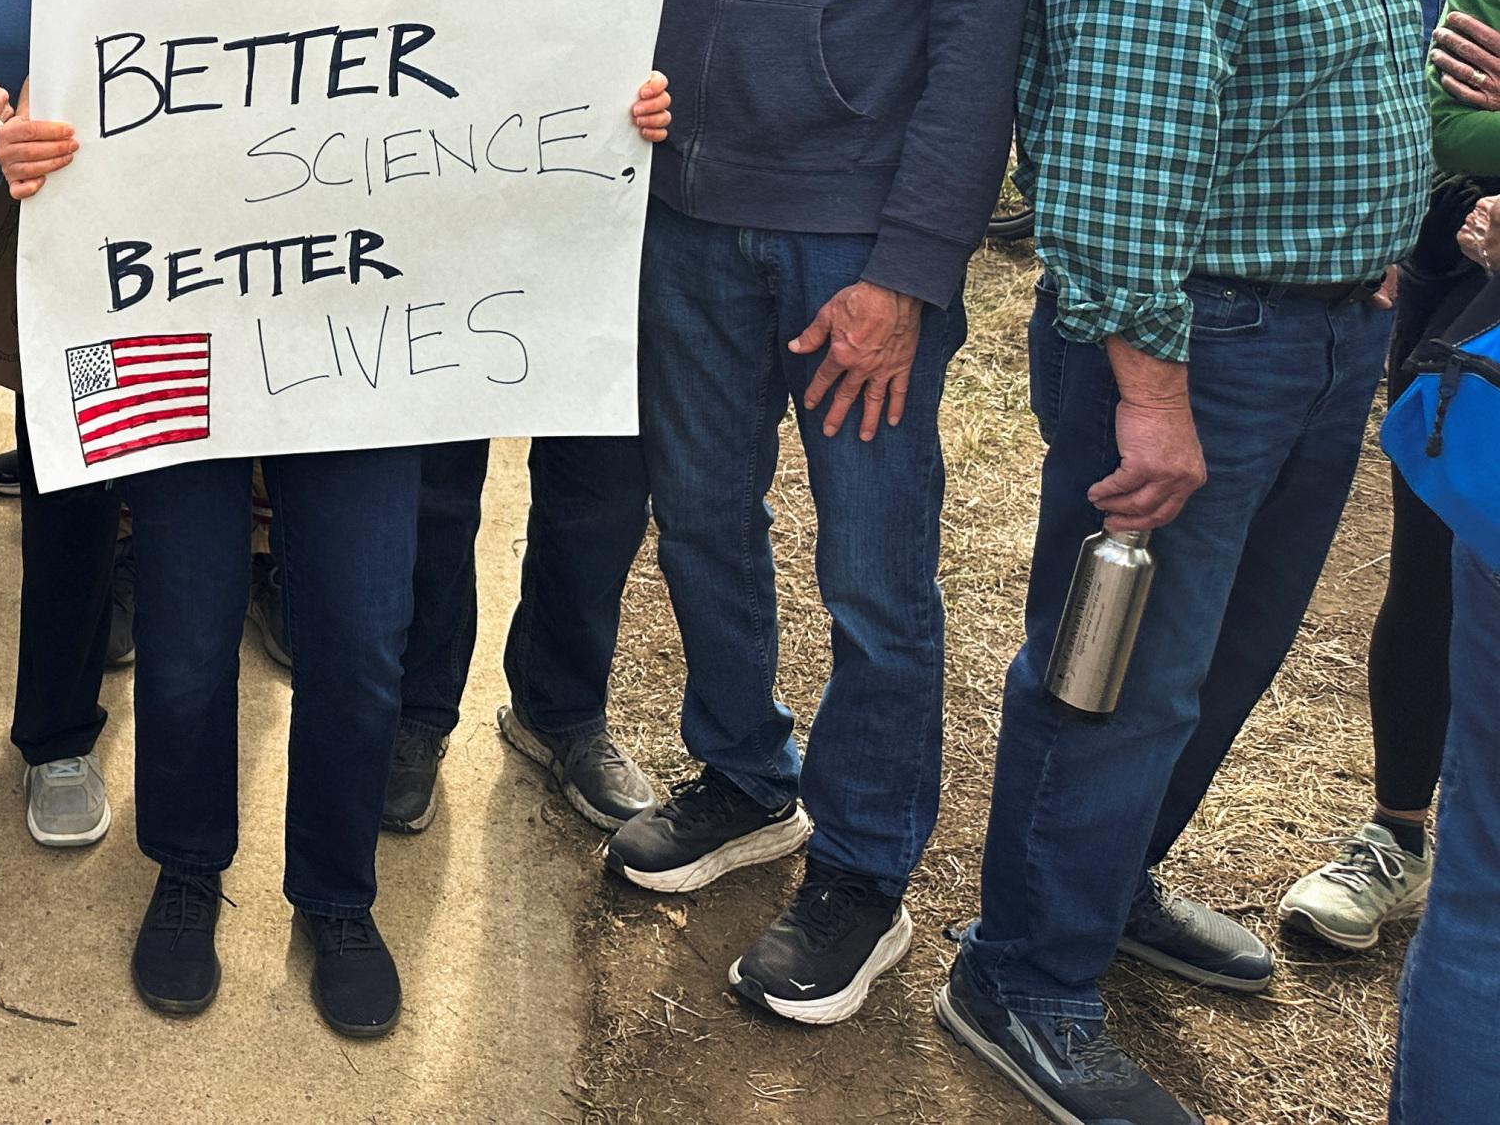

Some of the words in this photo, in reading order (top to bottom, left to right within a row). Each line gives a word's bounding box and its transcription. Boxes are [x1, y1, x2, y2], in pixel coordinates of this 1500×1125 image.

[94, 22, 459, 139] BETTER
[244, 105, 637, 203] SCIENCE,
[100, 228, 404, 314] BETTER
[256, 289, 530, 397] LIVES
